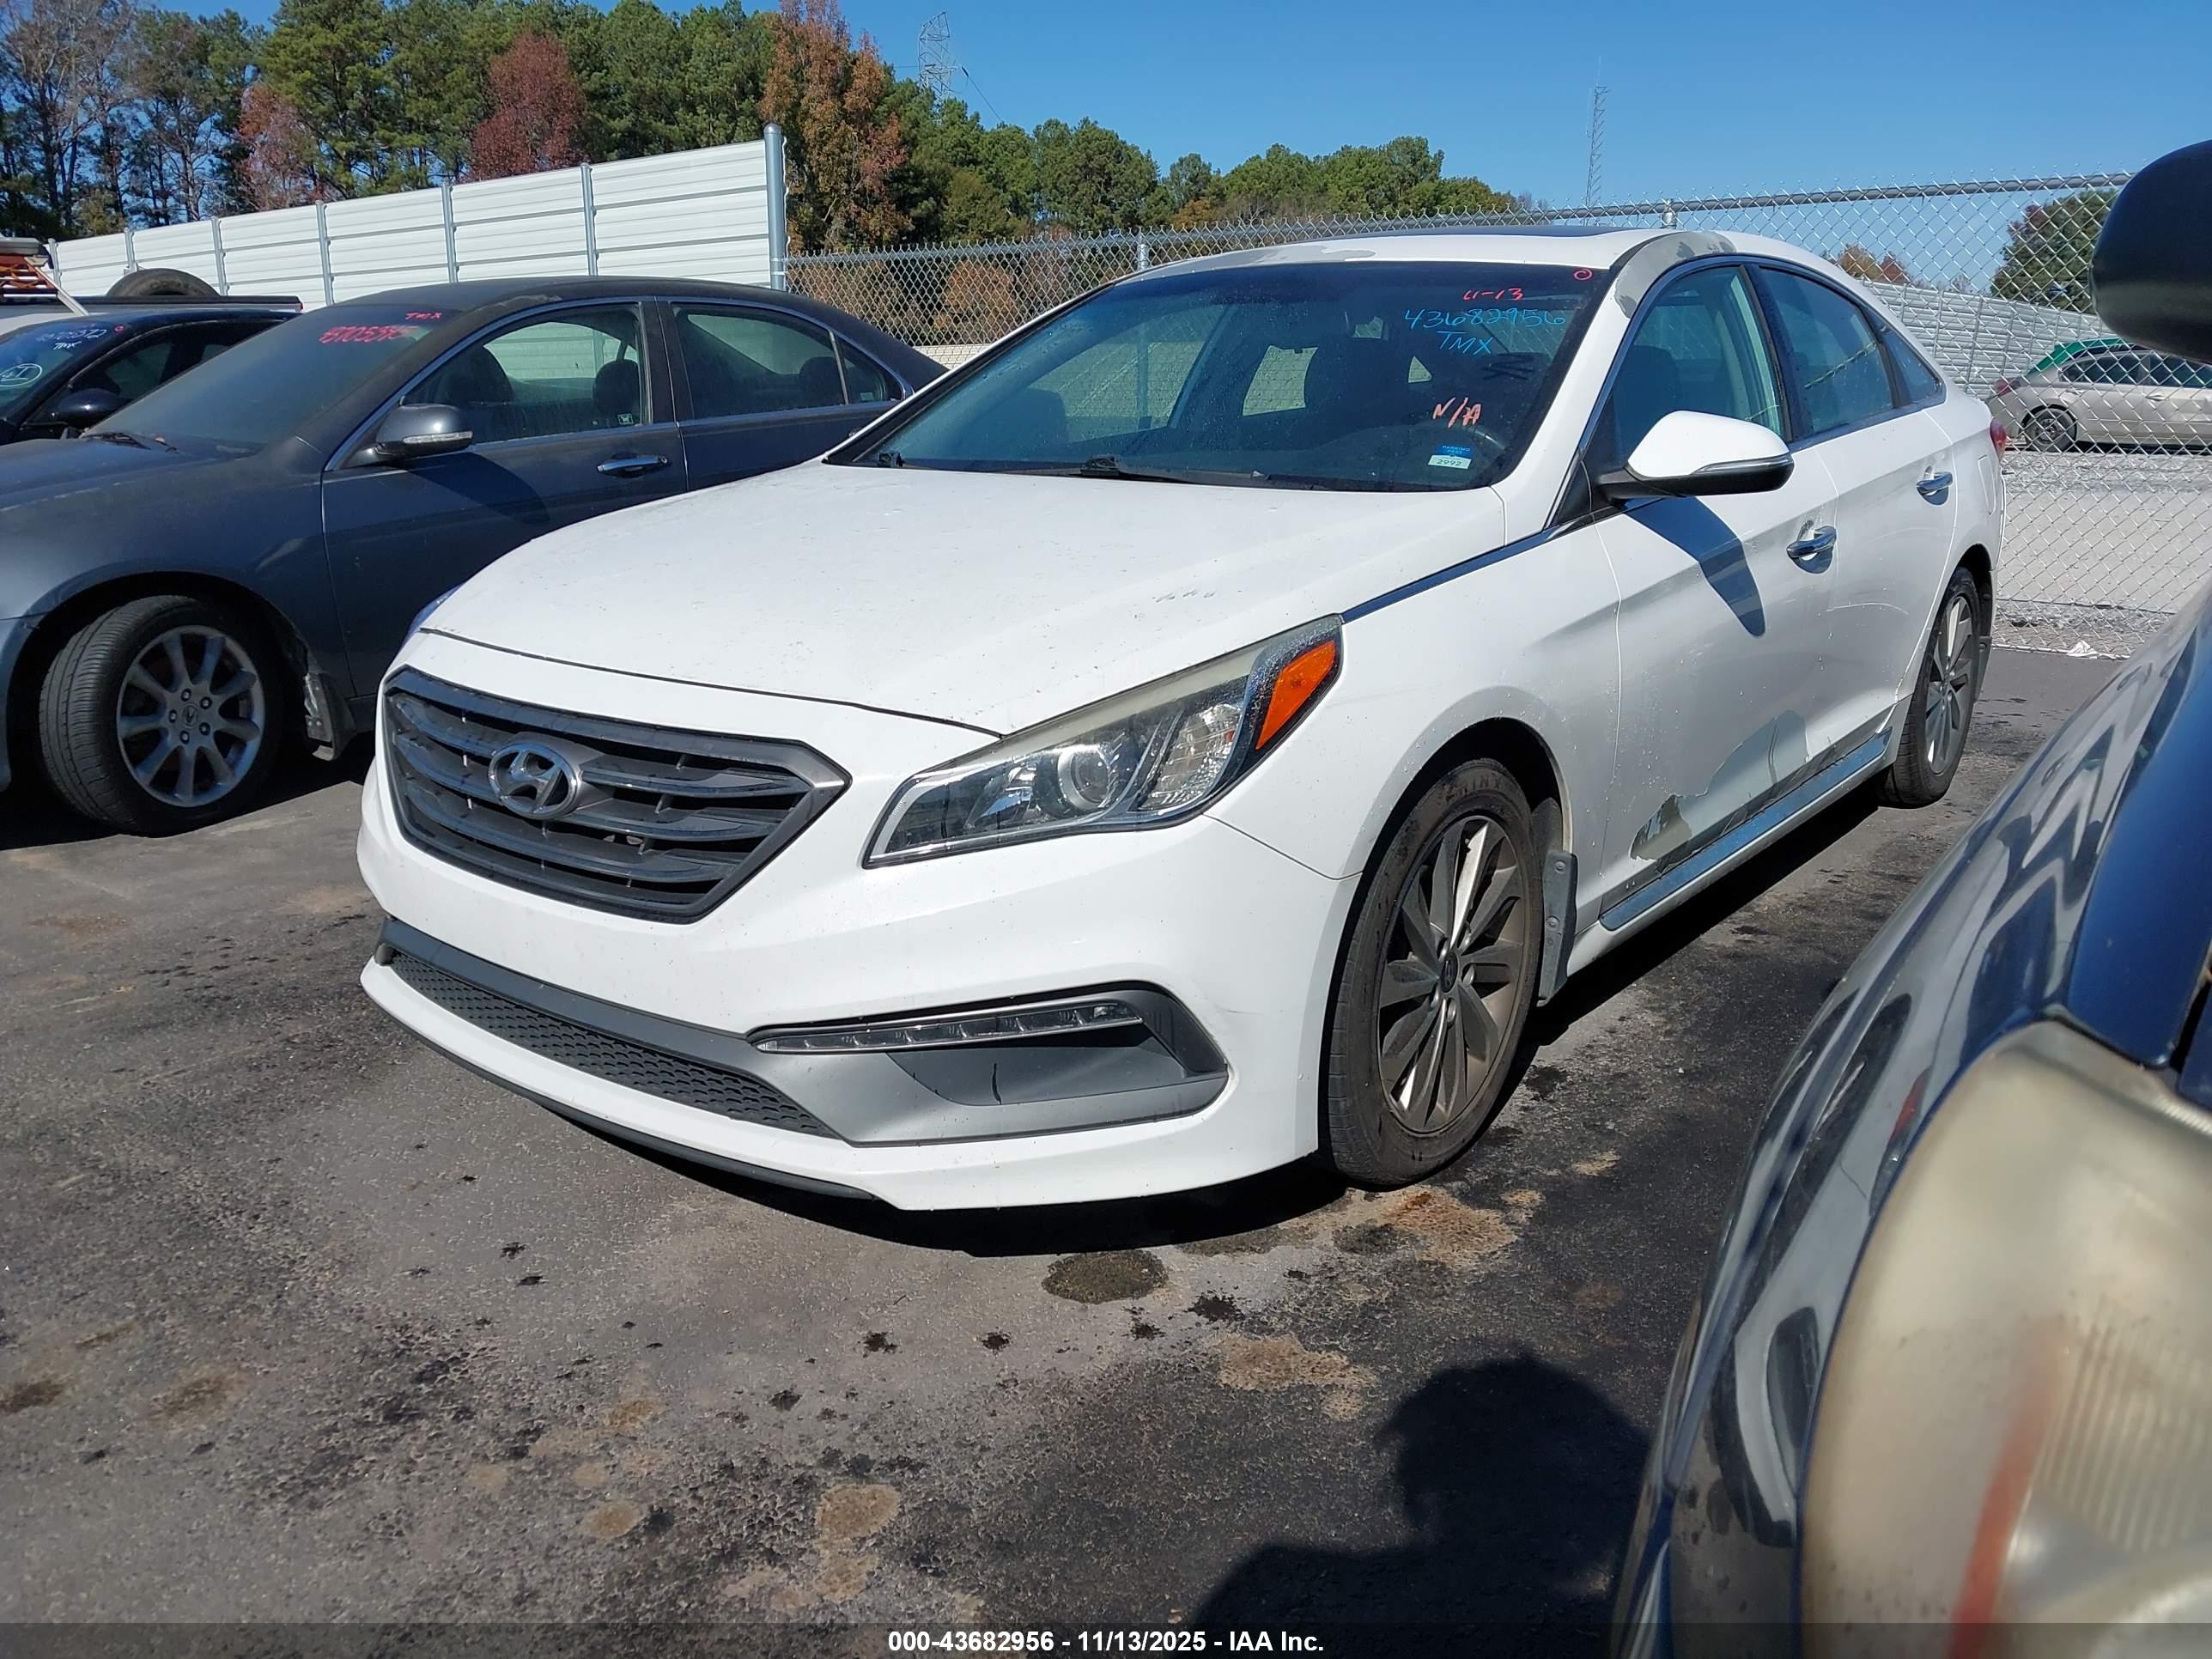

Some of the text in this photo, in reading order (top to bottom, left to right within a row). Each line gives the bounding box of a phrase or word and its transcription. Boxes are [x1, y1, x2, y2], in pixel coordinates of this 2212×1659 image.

[1404, 307, 1567, 329] 43682956
[1436, 331, 1494, 356] TMX
[1432, 397, 1483, 428] N/A
